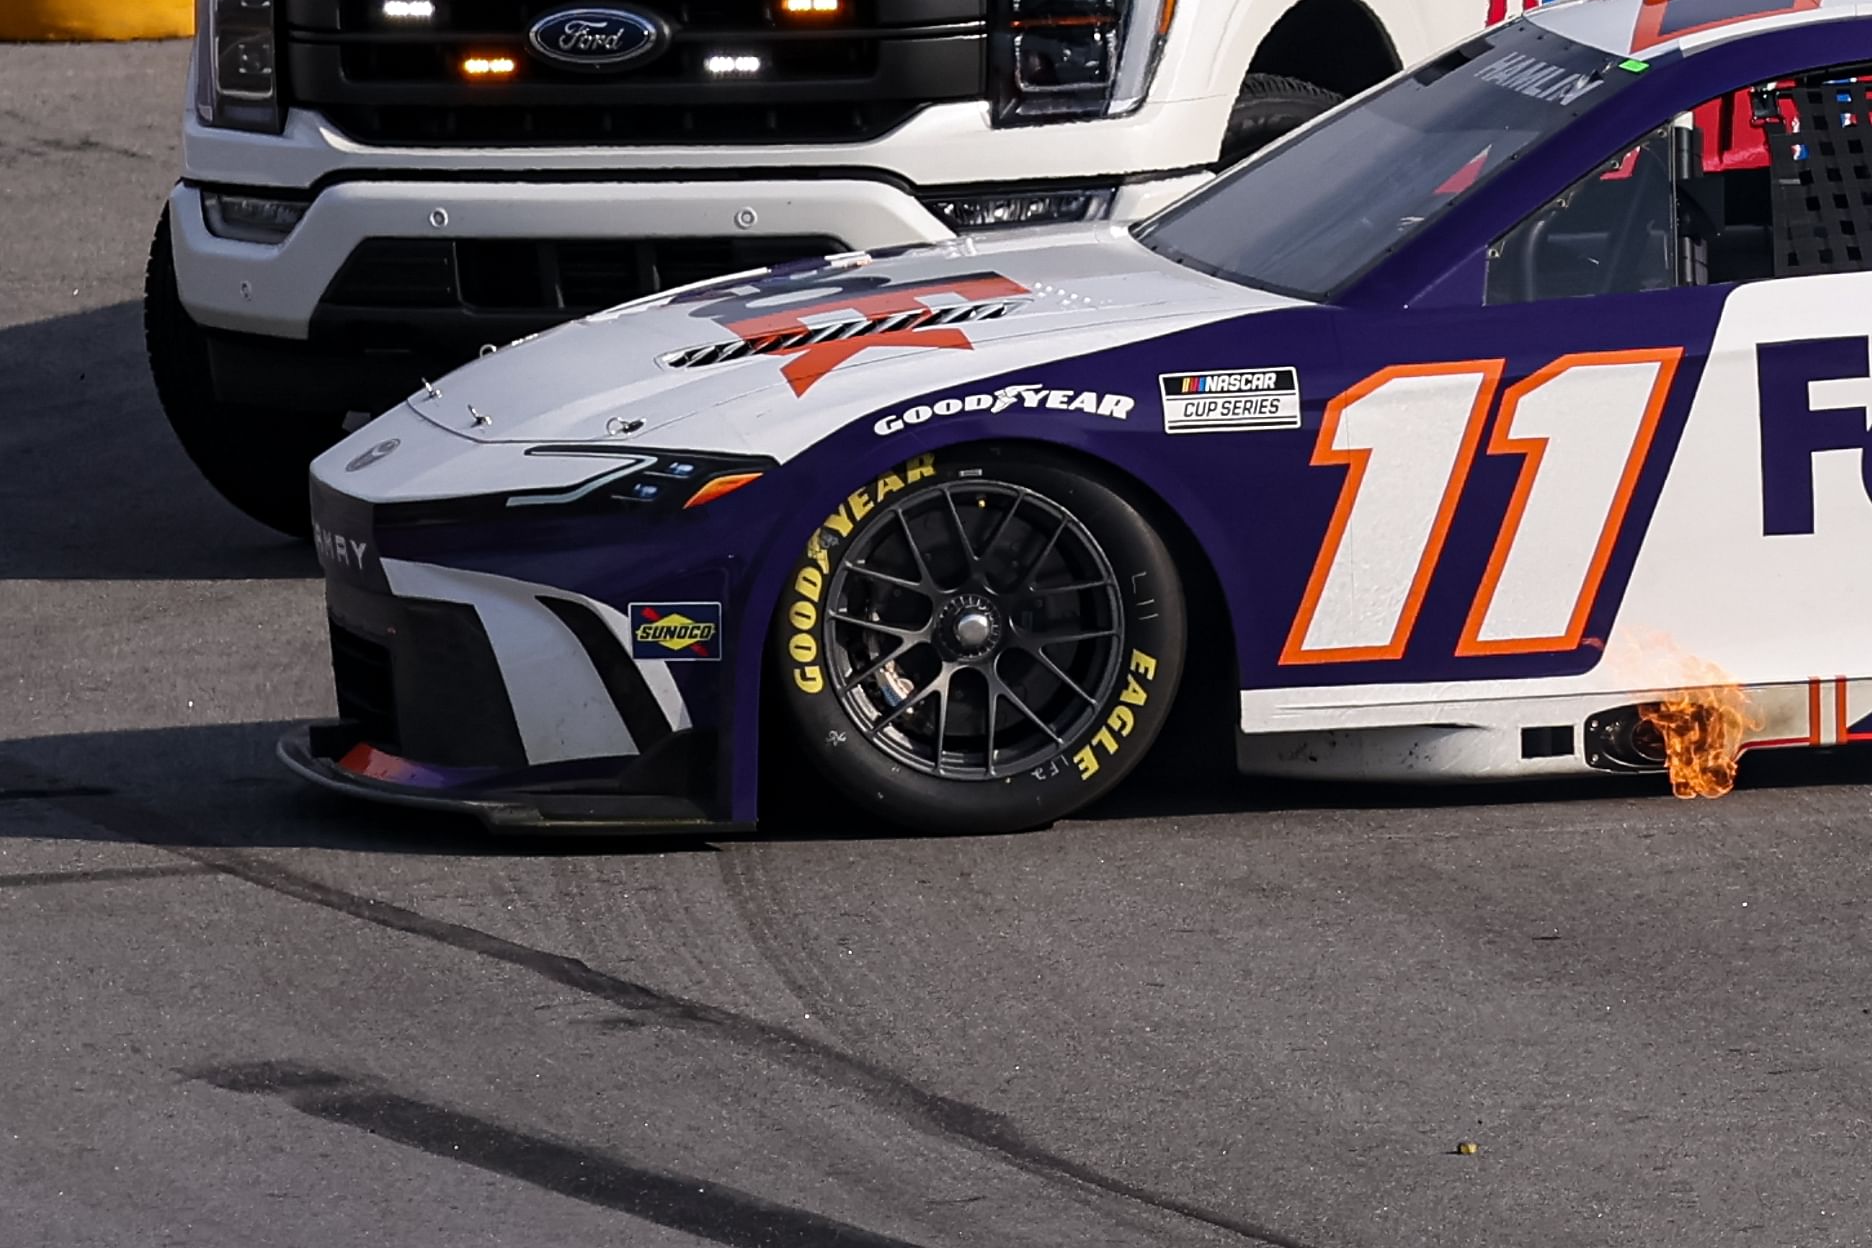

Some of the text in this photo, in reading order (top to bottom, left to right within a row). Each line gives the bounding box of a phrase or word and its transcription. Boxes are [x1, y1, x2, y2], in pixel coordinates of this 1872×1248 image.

[559, 20, 624, 50] Ford
[1473, 51, 1605, 106] HAMLIN
[1183, 395, 1281, 419] CUP SERIES
[1205, 371, 1278, 392] NASCAR
[873, 383, 1136, 437] GOODYEAR
[1279, 346, 1685, 665] 11
[788, 452, 937, 694] GOODYEAR
[639, 624, 714, 640] SUNOCO
[1073, 648, 1158, 781] EAGLE
